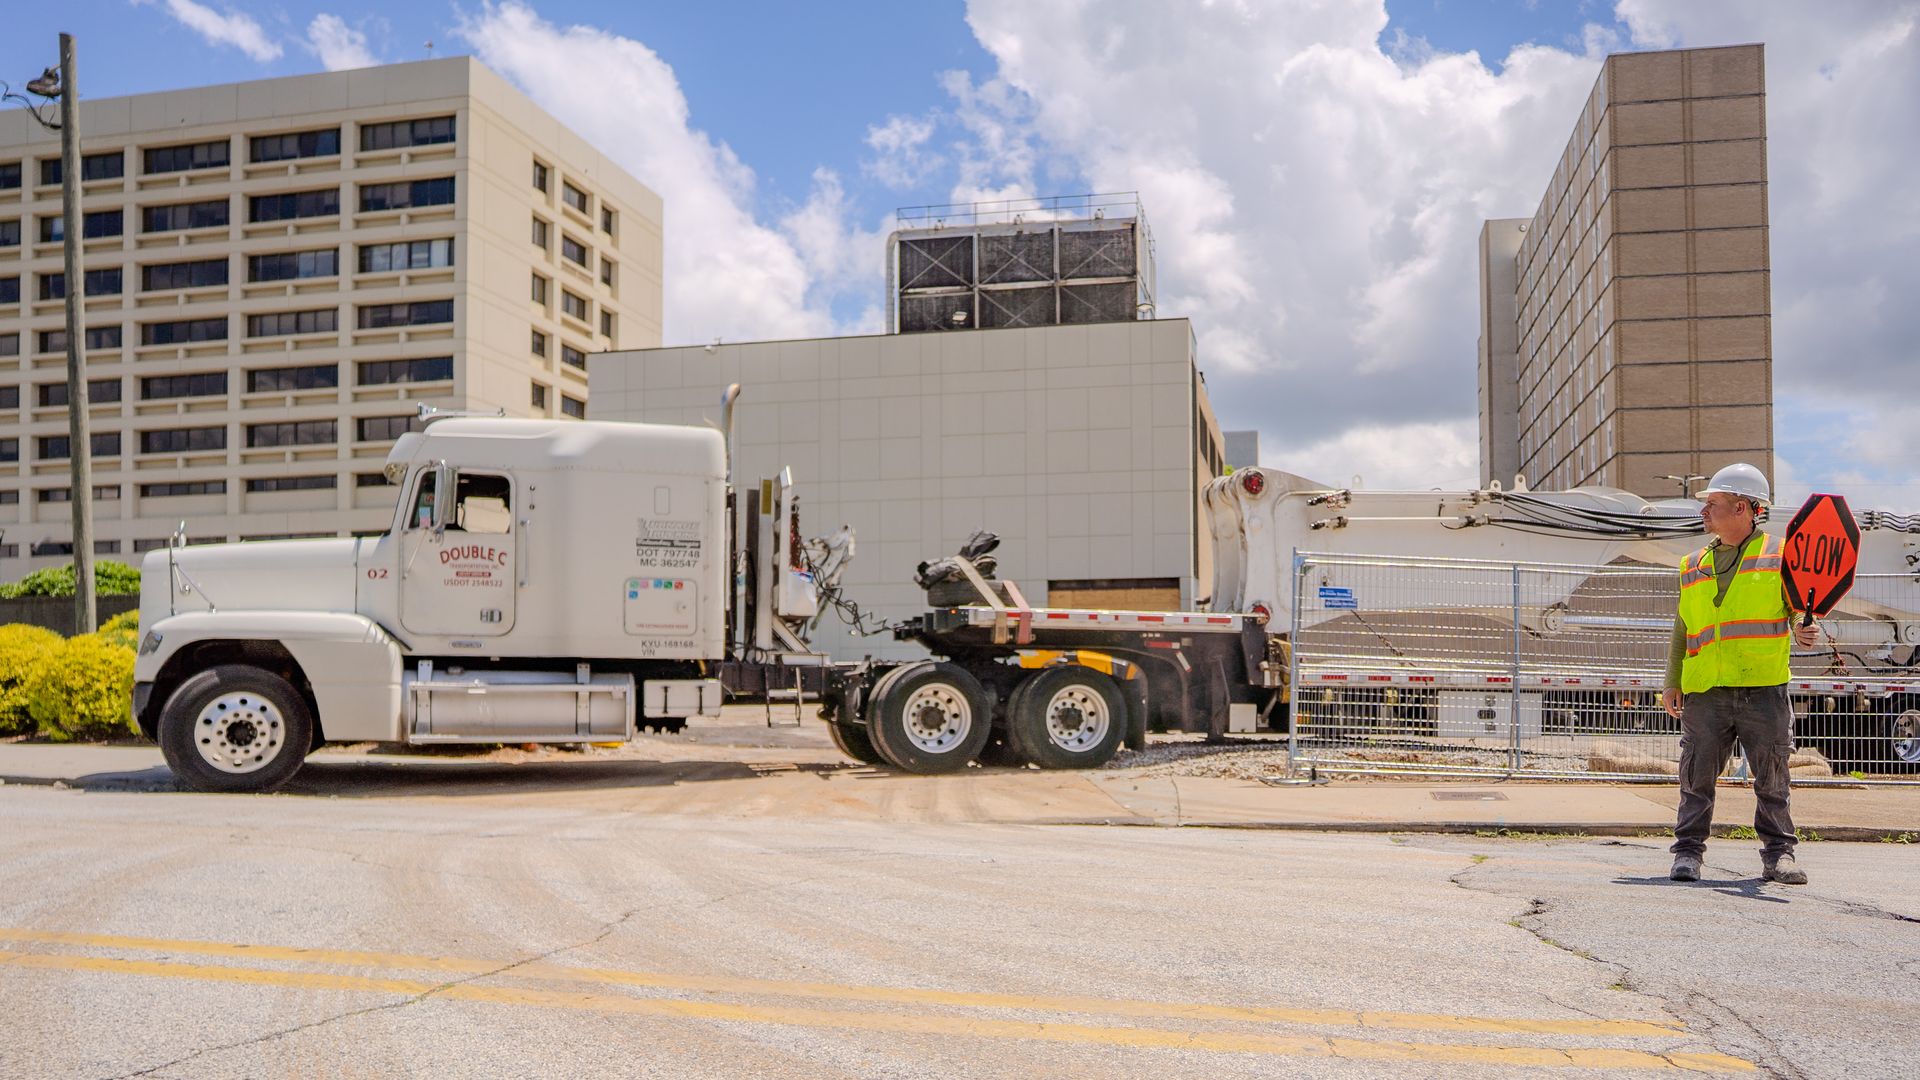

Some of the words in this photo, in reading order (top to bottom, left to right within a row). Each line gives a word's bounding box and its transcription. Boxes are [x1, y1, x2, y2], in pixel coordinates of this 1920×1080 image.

[440, 545, 495, 564] DOUBLE
[498, 551, 507, 566] C
[636, 549, 659, 557] DOT
[663, 549, 700, 558] 797748
[1790, 532, 1846, 577] SLOW
[640, 558, 657, 567] MC
[660, 559, 698, 568] 362547
[367, 568, 388, 579] 02
[443, 578, 470, 587] USDOT
[641, 648, 655, 657] VIN
